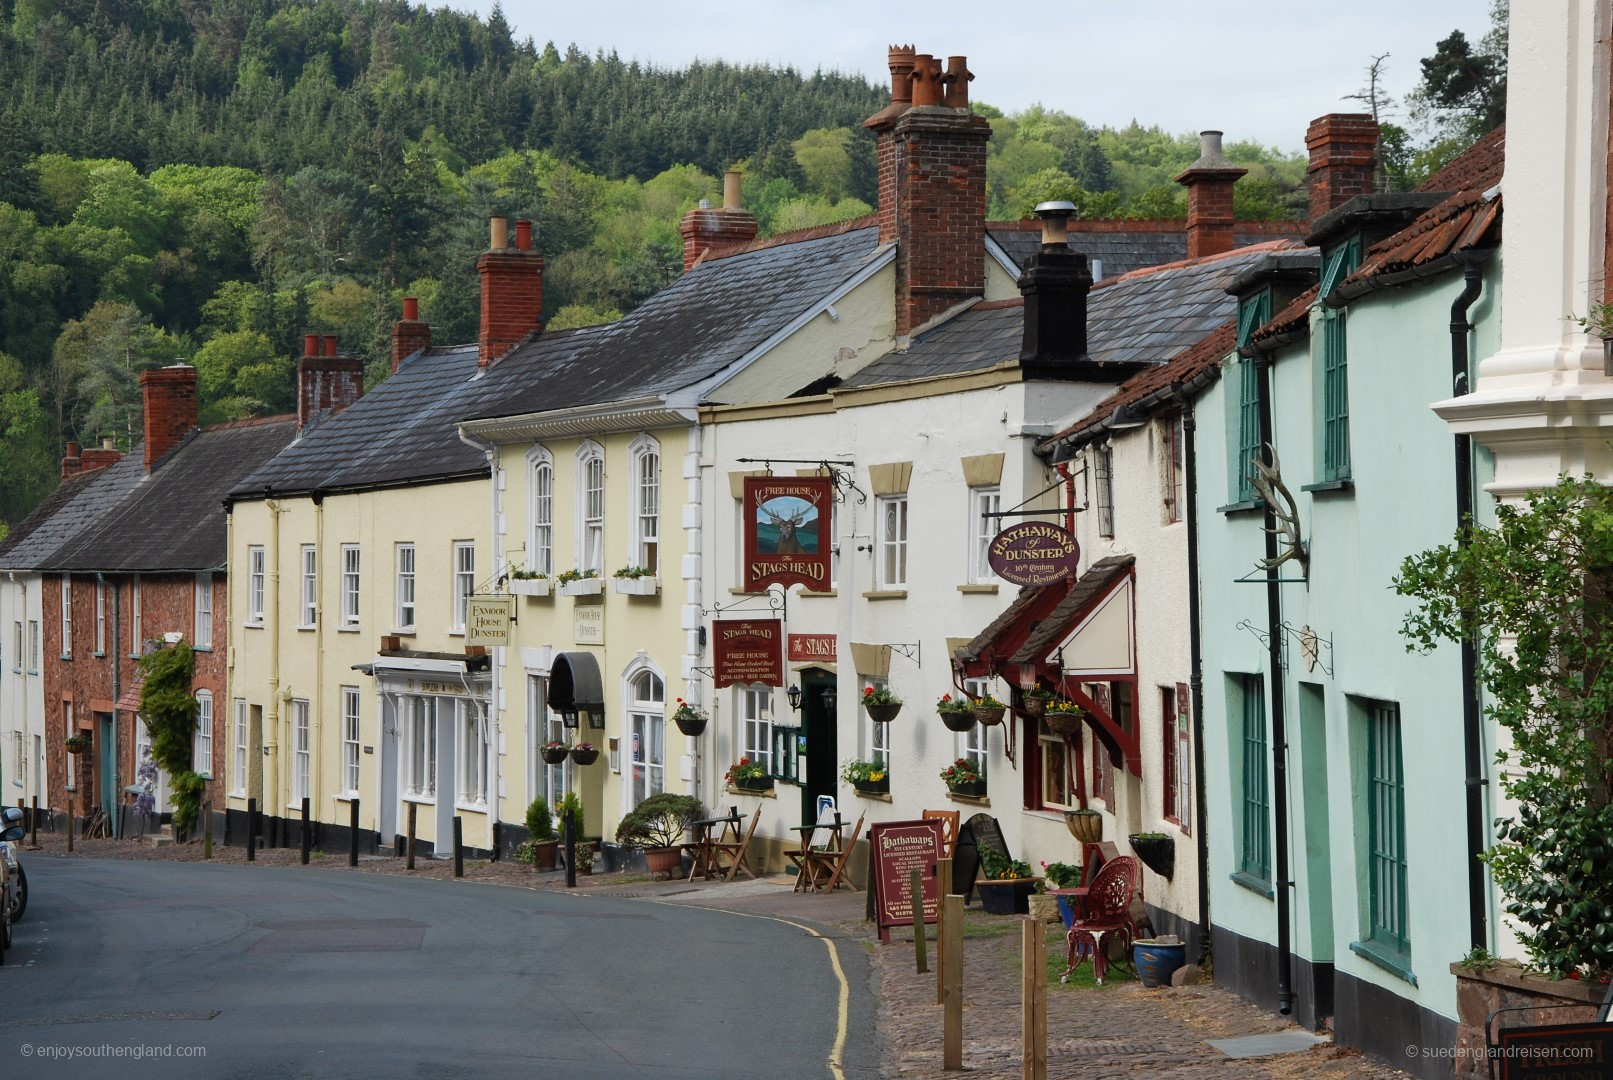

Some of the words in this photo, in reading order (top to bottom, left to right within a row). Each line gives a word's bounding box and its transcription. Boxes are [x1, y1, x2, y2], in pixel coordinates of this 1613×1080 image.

[765, 487, 785, 495] FREE
[786, 487, 811, 495] HOUSE
[993, 526, 1075, 556] HATHAWAYS
[1005, 548, 1065, 561] DUNSTER
[752, 562, 788, 581] STAGS
[790, 562, 825, 581] HEAD
[1029, 564, 1055, 574] Century
[1002, 566, 1032, 583] Licensed
[1033, 566, 1069, 584] Restaurant
[473, 605, 506, 616] EXMOOR
[476, 617, 501, 627] HOUSE
[470, 628, 506, 639] DUNSTER
[723, 630, 747, 640] STAGS
[749, 629, 772, 639] HEAD
[806, 638, 830, 655] STAGS
[882, 836, 934, 852] Hathaways
[906, 849, 935, 857] RESTAURANT
